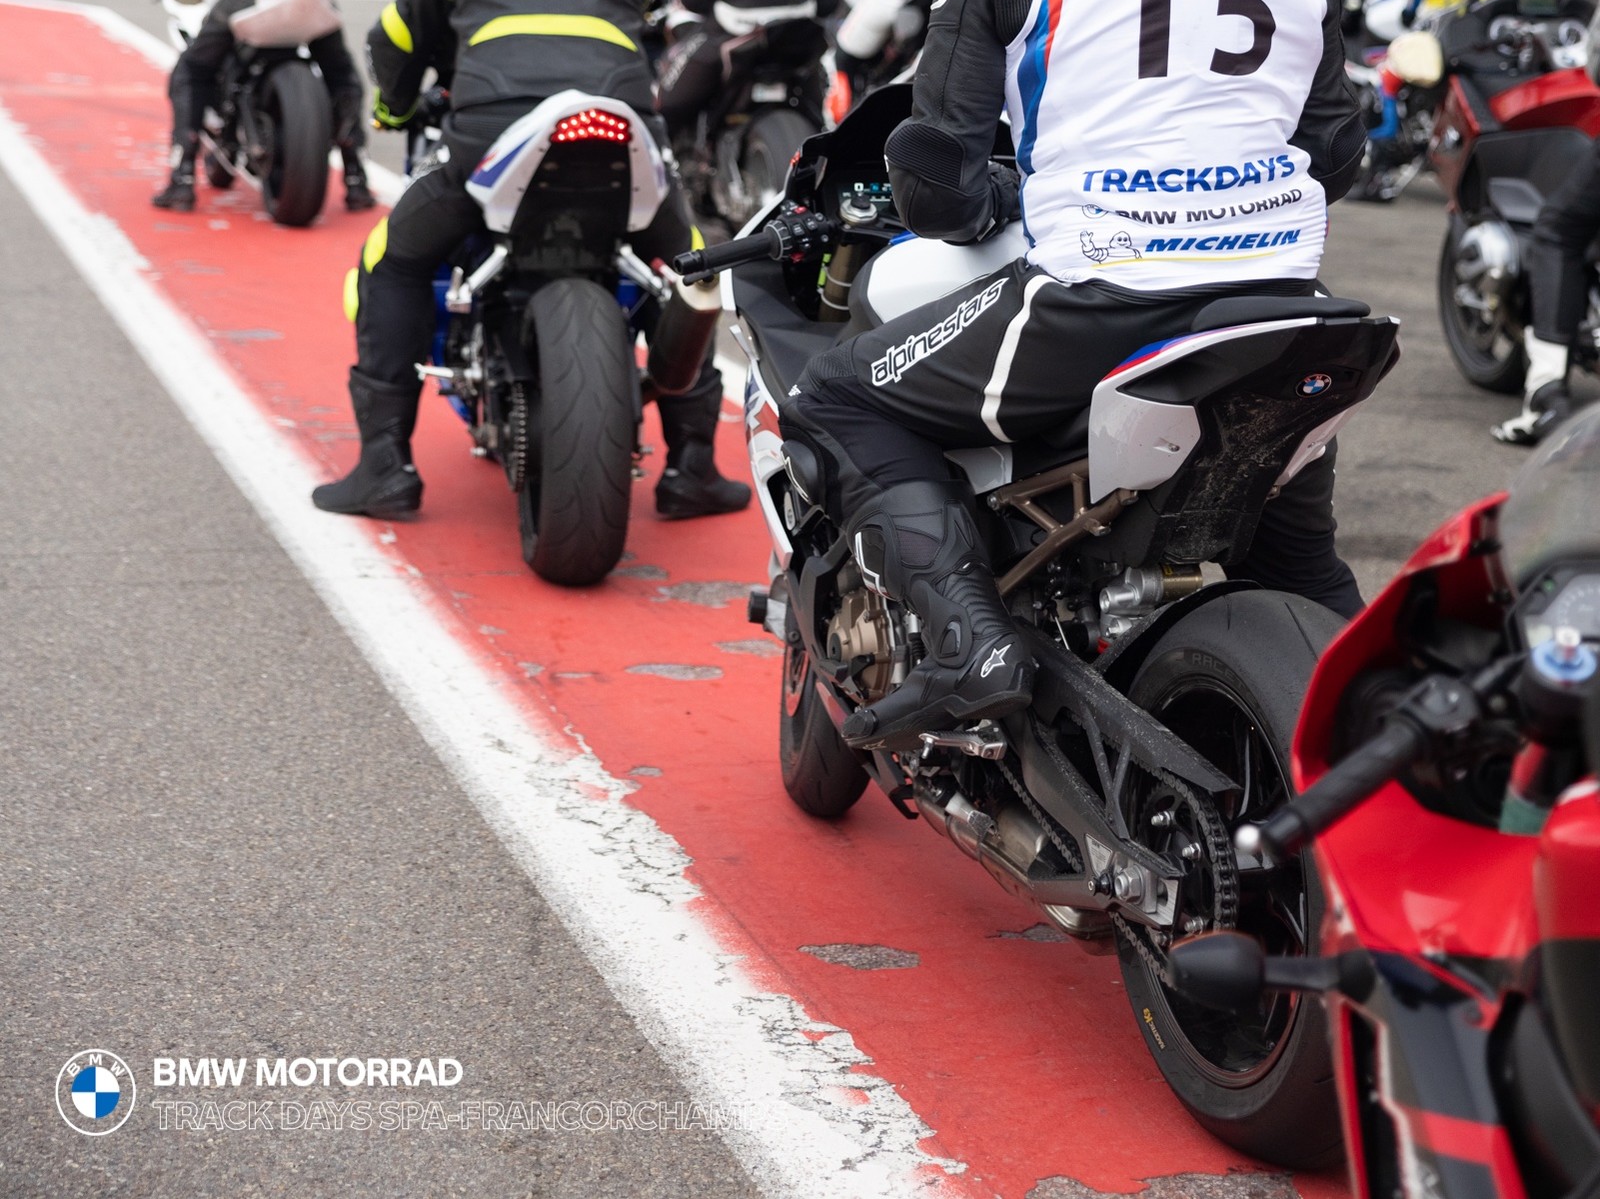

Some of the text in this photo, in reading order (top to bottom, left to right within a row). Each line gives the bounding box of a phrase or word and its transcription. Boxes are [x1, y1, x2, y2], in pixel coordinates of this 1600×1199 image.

[1082, 154, 1296, 193] TRACKDAYS
[1145, 229, 1302, 253] MICHELIN
[870, 277, 1010, 387] alpinestars
